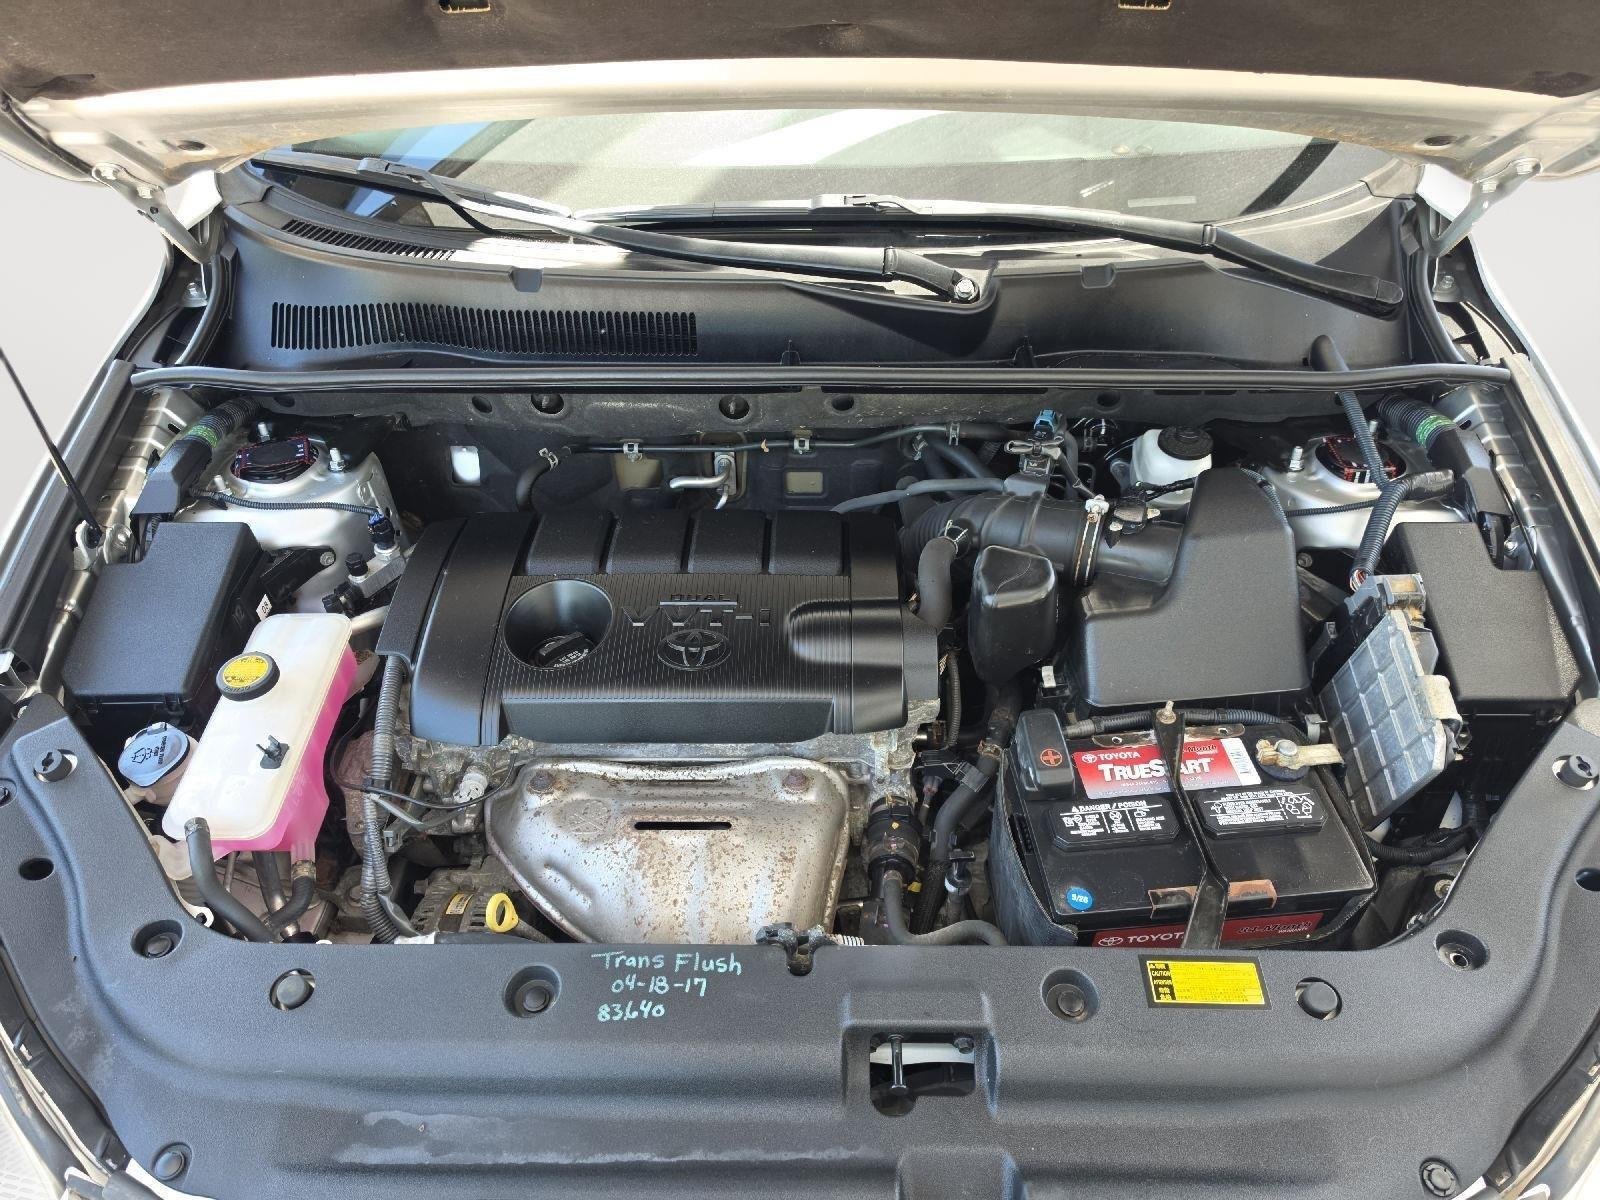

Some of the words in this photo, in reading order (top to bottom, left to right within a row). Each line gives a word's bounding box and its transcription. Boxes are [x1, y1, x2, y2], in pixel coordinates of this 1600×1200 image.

[1098, 751, 1142, 761] TOYOTA
[1097, 757, 1212, 782] TRUESART
[1128, 931, 1184, 943] TOYOT
[591, 951, 665, 970] Trans
[675, 952, 742, 975] Flush
[611, 974, 707, 997] 04-18-17
